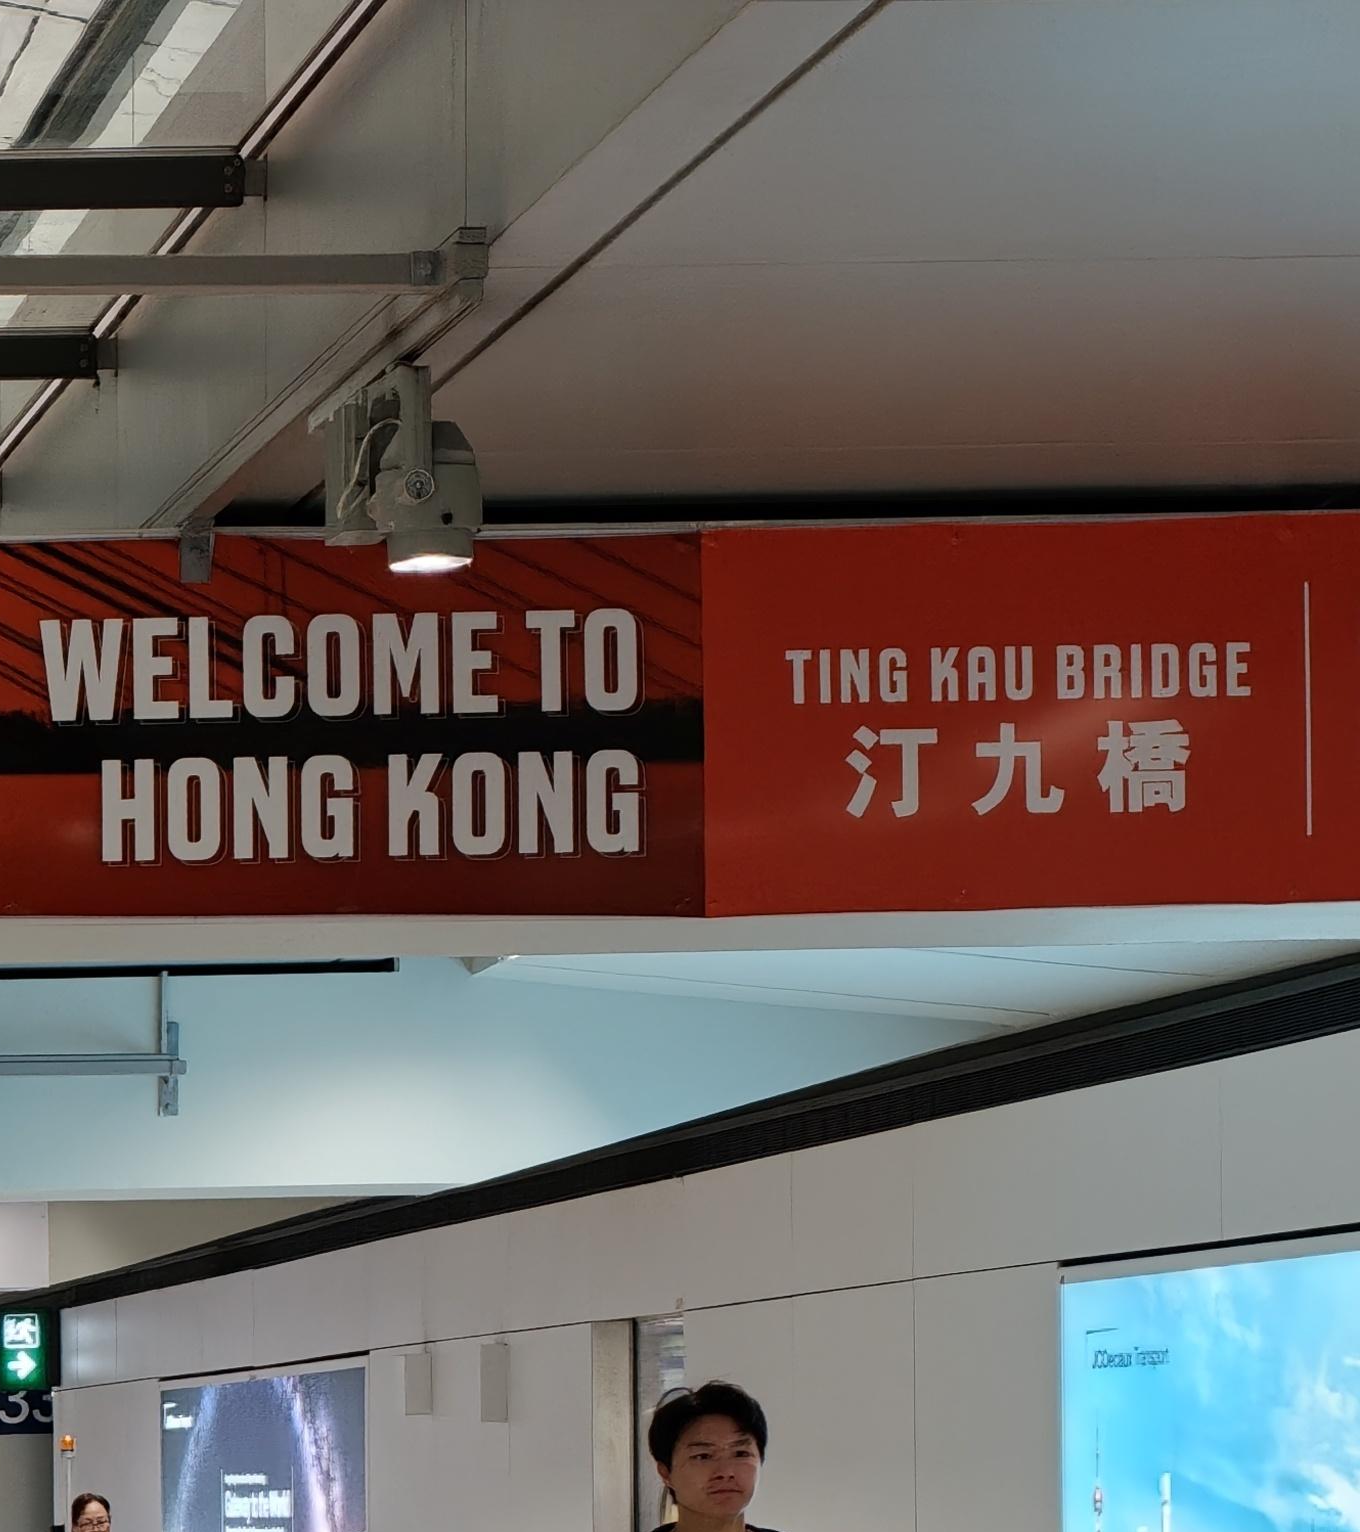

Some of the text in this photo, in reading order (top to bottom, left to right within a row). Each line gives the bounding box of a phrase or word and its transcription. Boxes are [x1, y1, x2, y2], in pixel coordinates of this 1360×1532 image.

[40, 608, 644, 726] WELCOME TO
[785, 642, 1252, 704] TING KAU BRIDGE
[101, 749, 646, 866] HONG KONG
[845, 718, 1191, 818] 汀九橋
